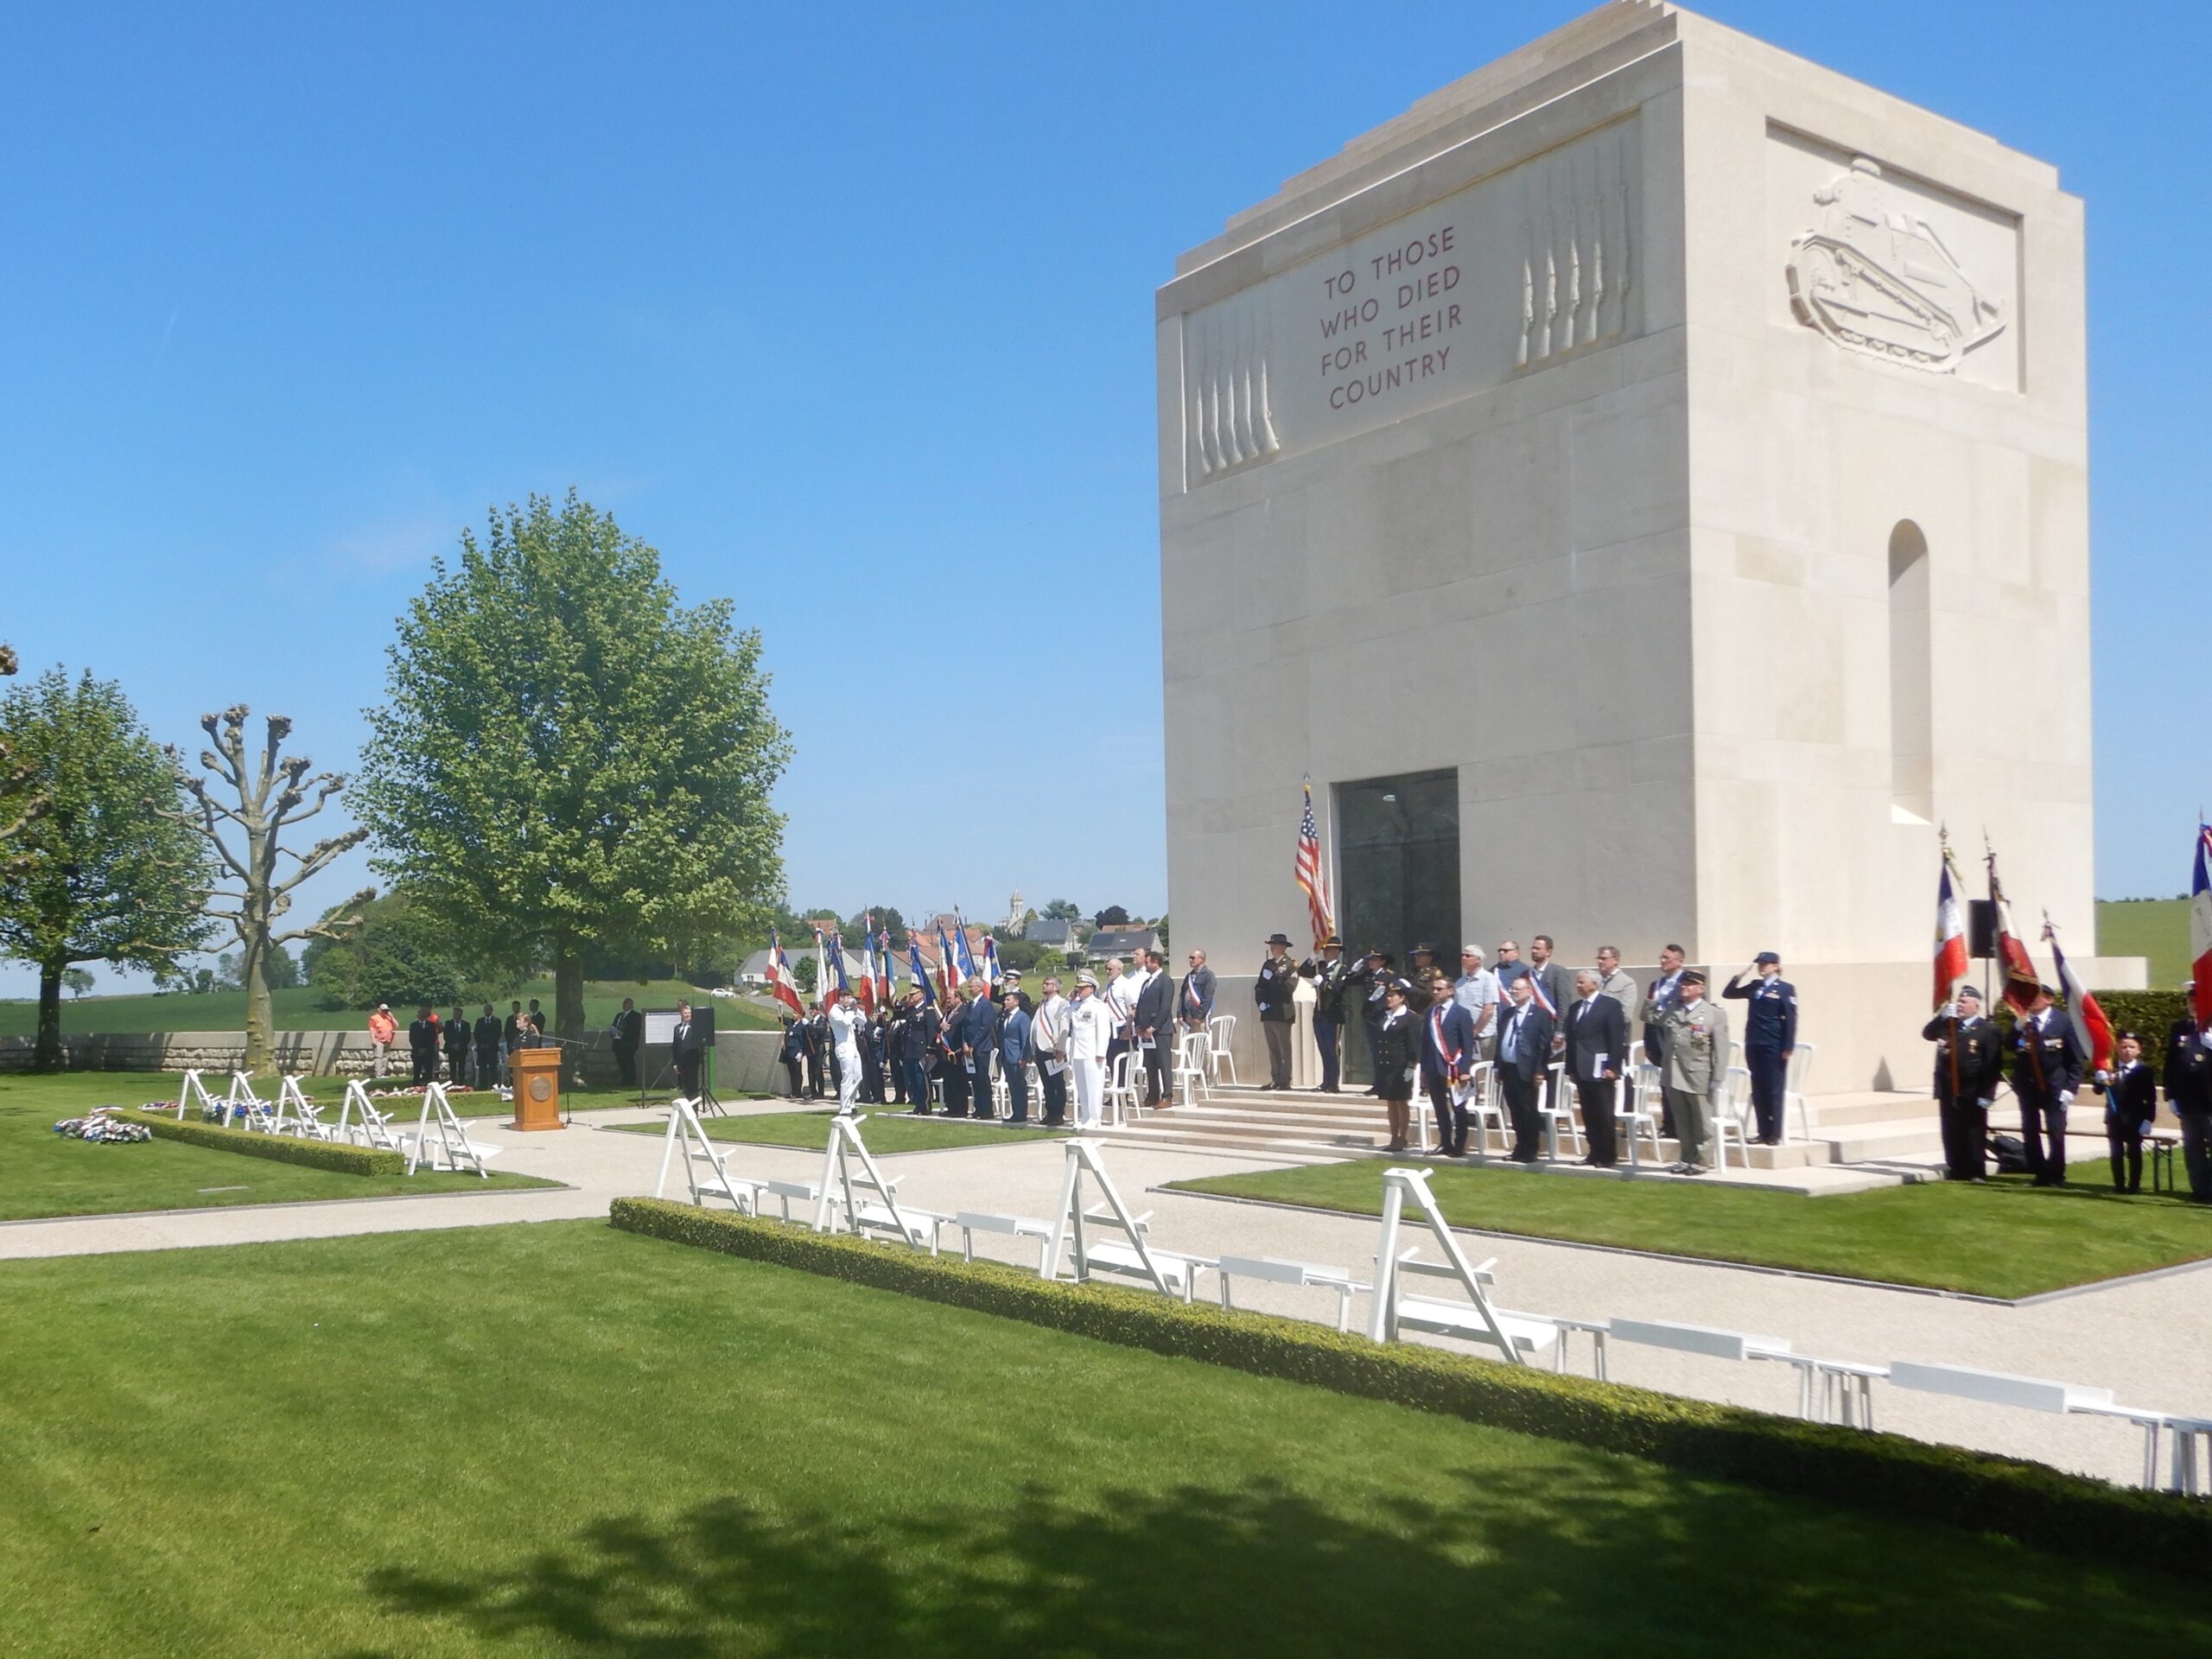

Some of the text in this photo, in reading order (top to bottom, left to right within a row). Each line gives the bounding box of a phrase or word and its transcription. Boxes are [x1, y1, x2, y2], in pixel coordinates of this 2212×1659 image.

[1325, 226, 1454, 299] TO THOSE
[1320, 266, 1460, 339] WHO DIED
[1322, 304, 1462, 377] FOR THEIR
[1330, 346, 1451, 410] COUNTRY
